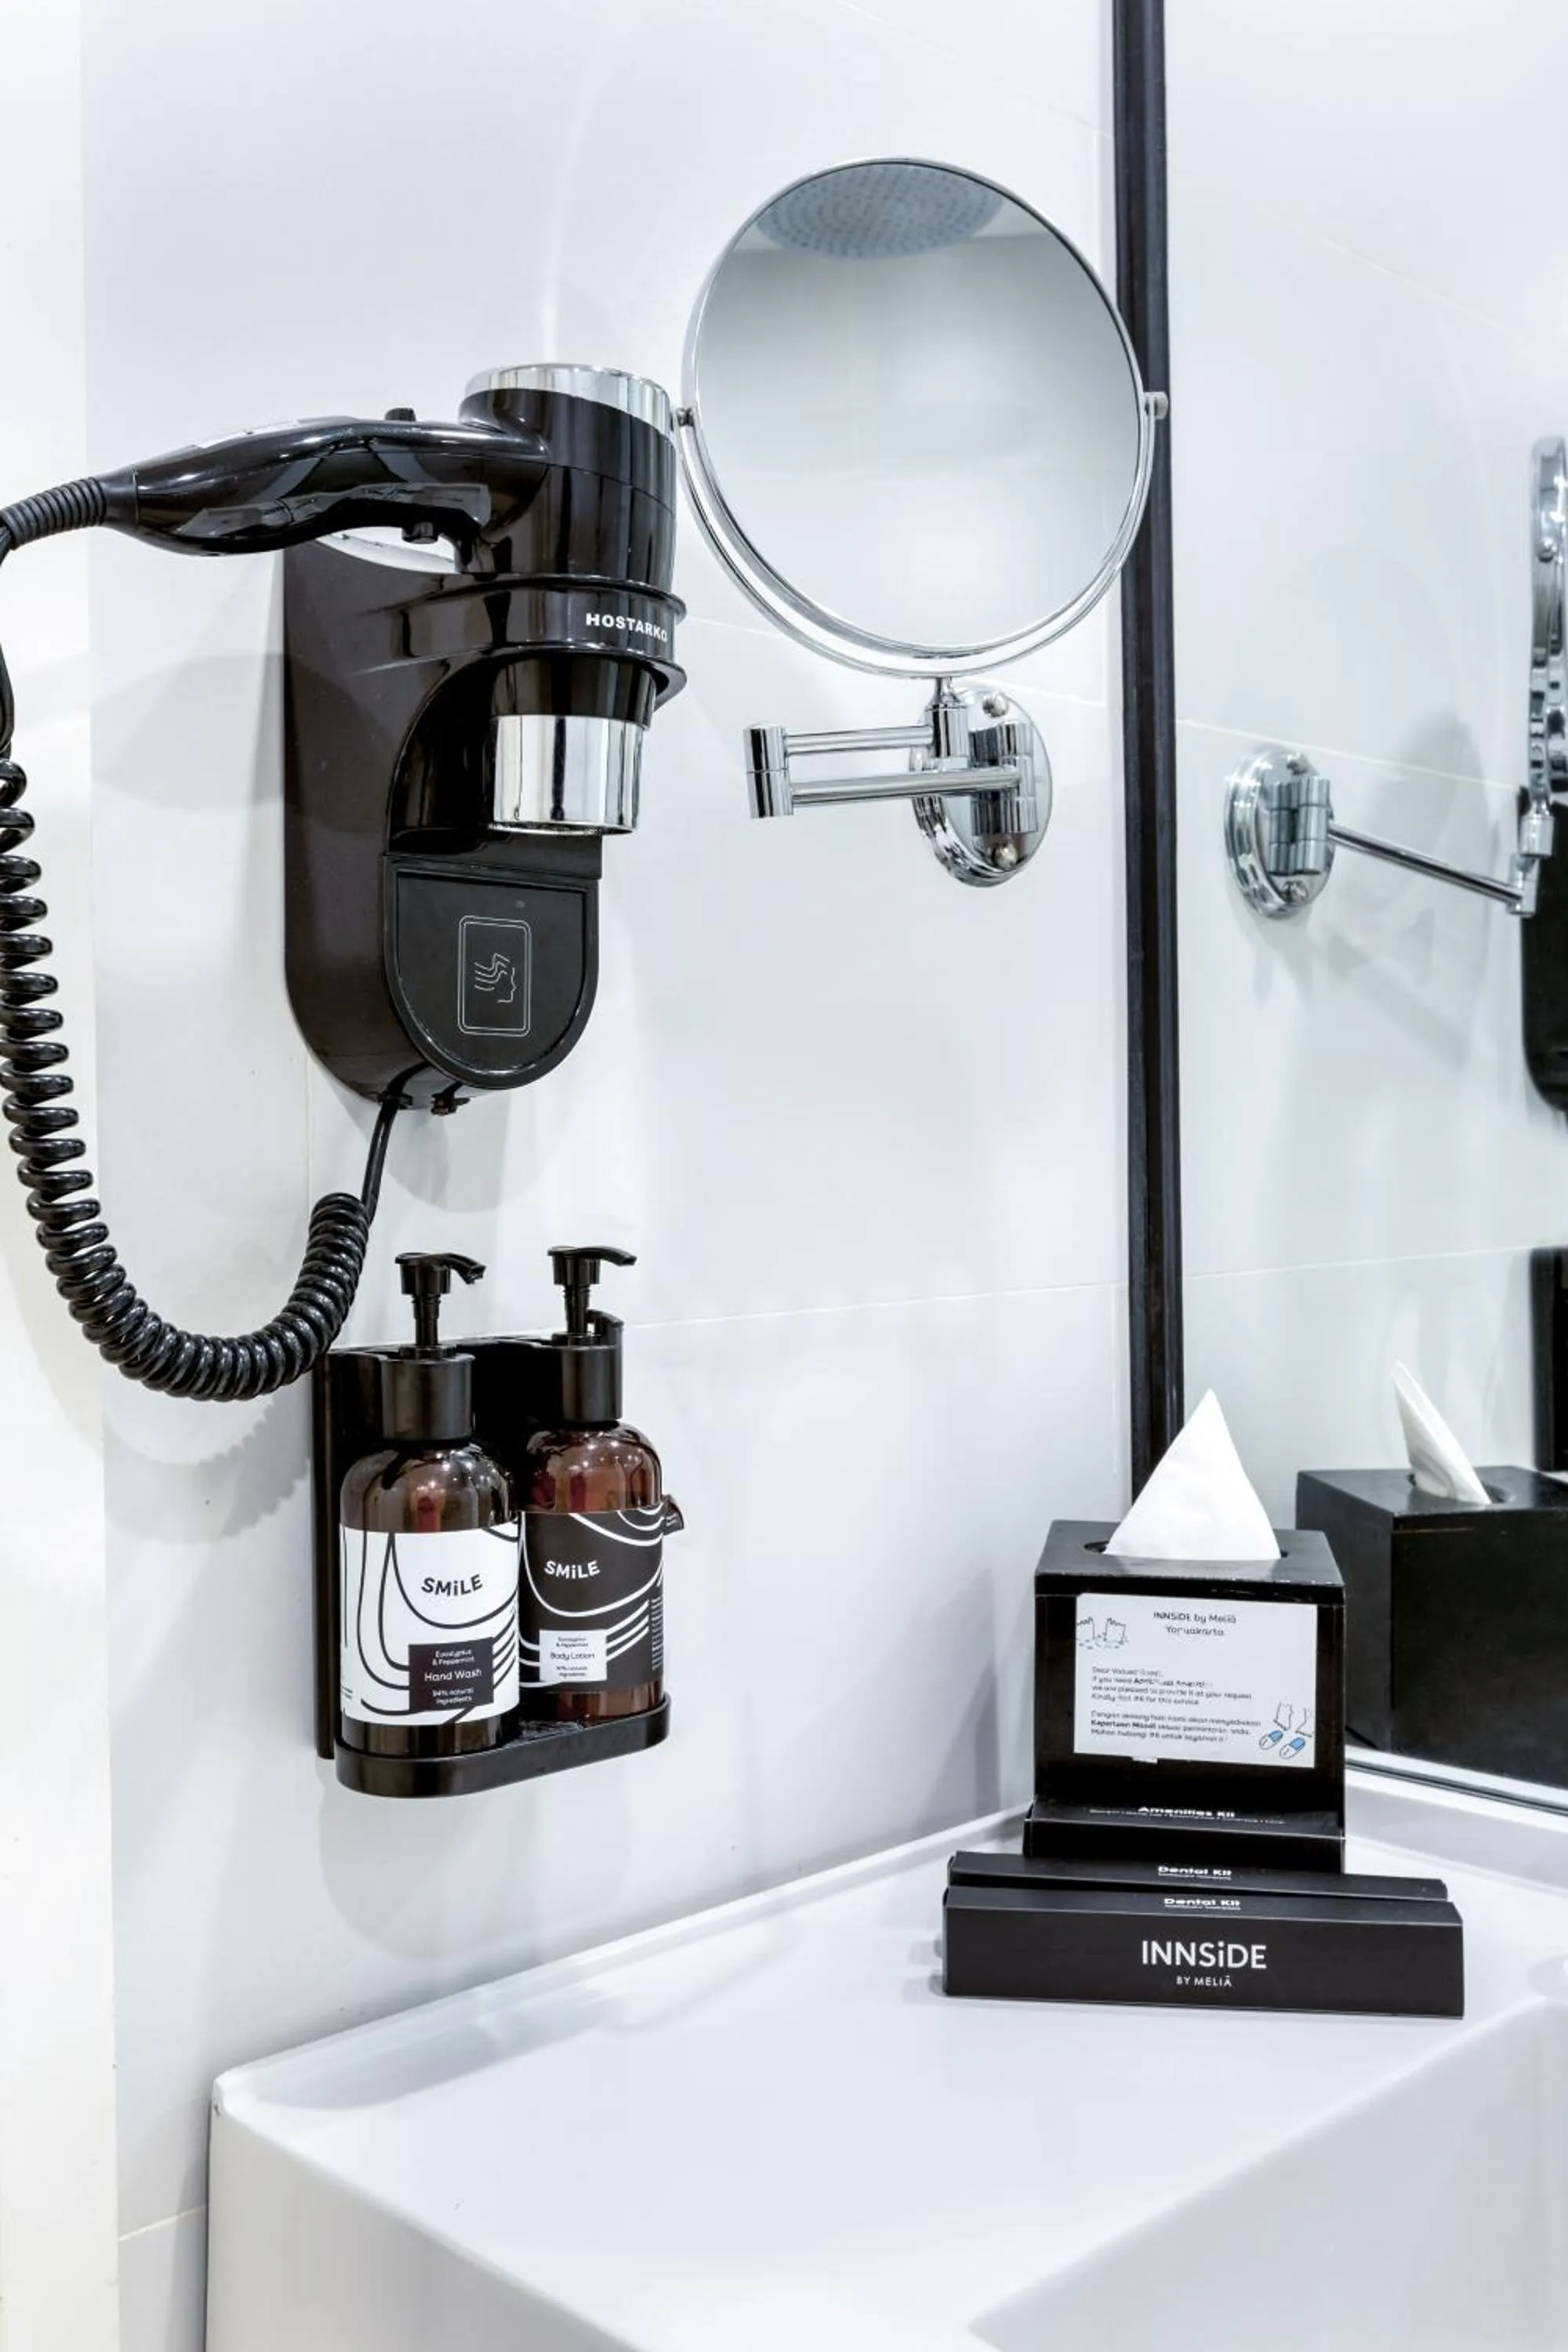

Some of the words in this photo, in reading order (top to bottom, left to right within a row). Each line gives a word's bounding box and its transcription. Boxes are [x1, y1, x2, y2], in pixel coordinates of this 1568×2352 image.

[586, 612, 667, 642] HOSTARKO
[1194, 1613, 1207, 1624] by
[550, 1652, 570, 1661] Body
[424, 1671, 452, 1682] Hand
[455, 1668, 483, 1680] Wash
[1158, 1866, 1208, 1875] Dental
[1177, 1976, 1191, 1985] BY
